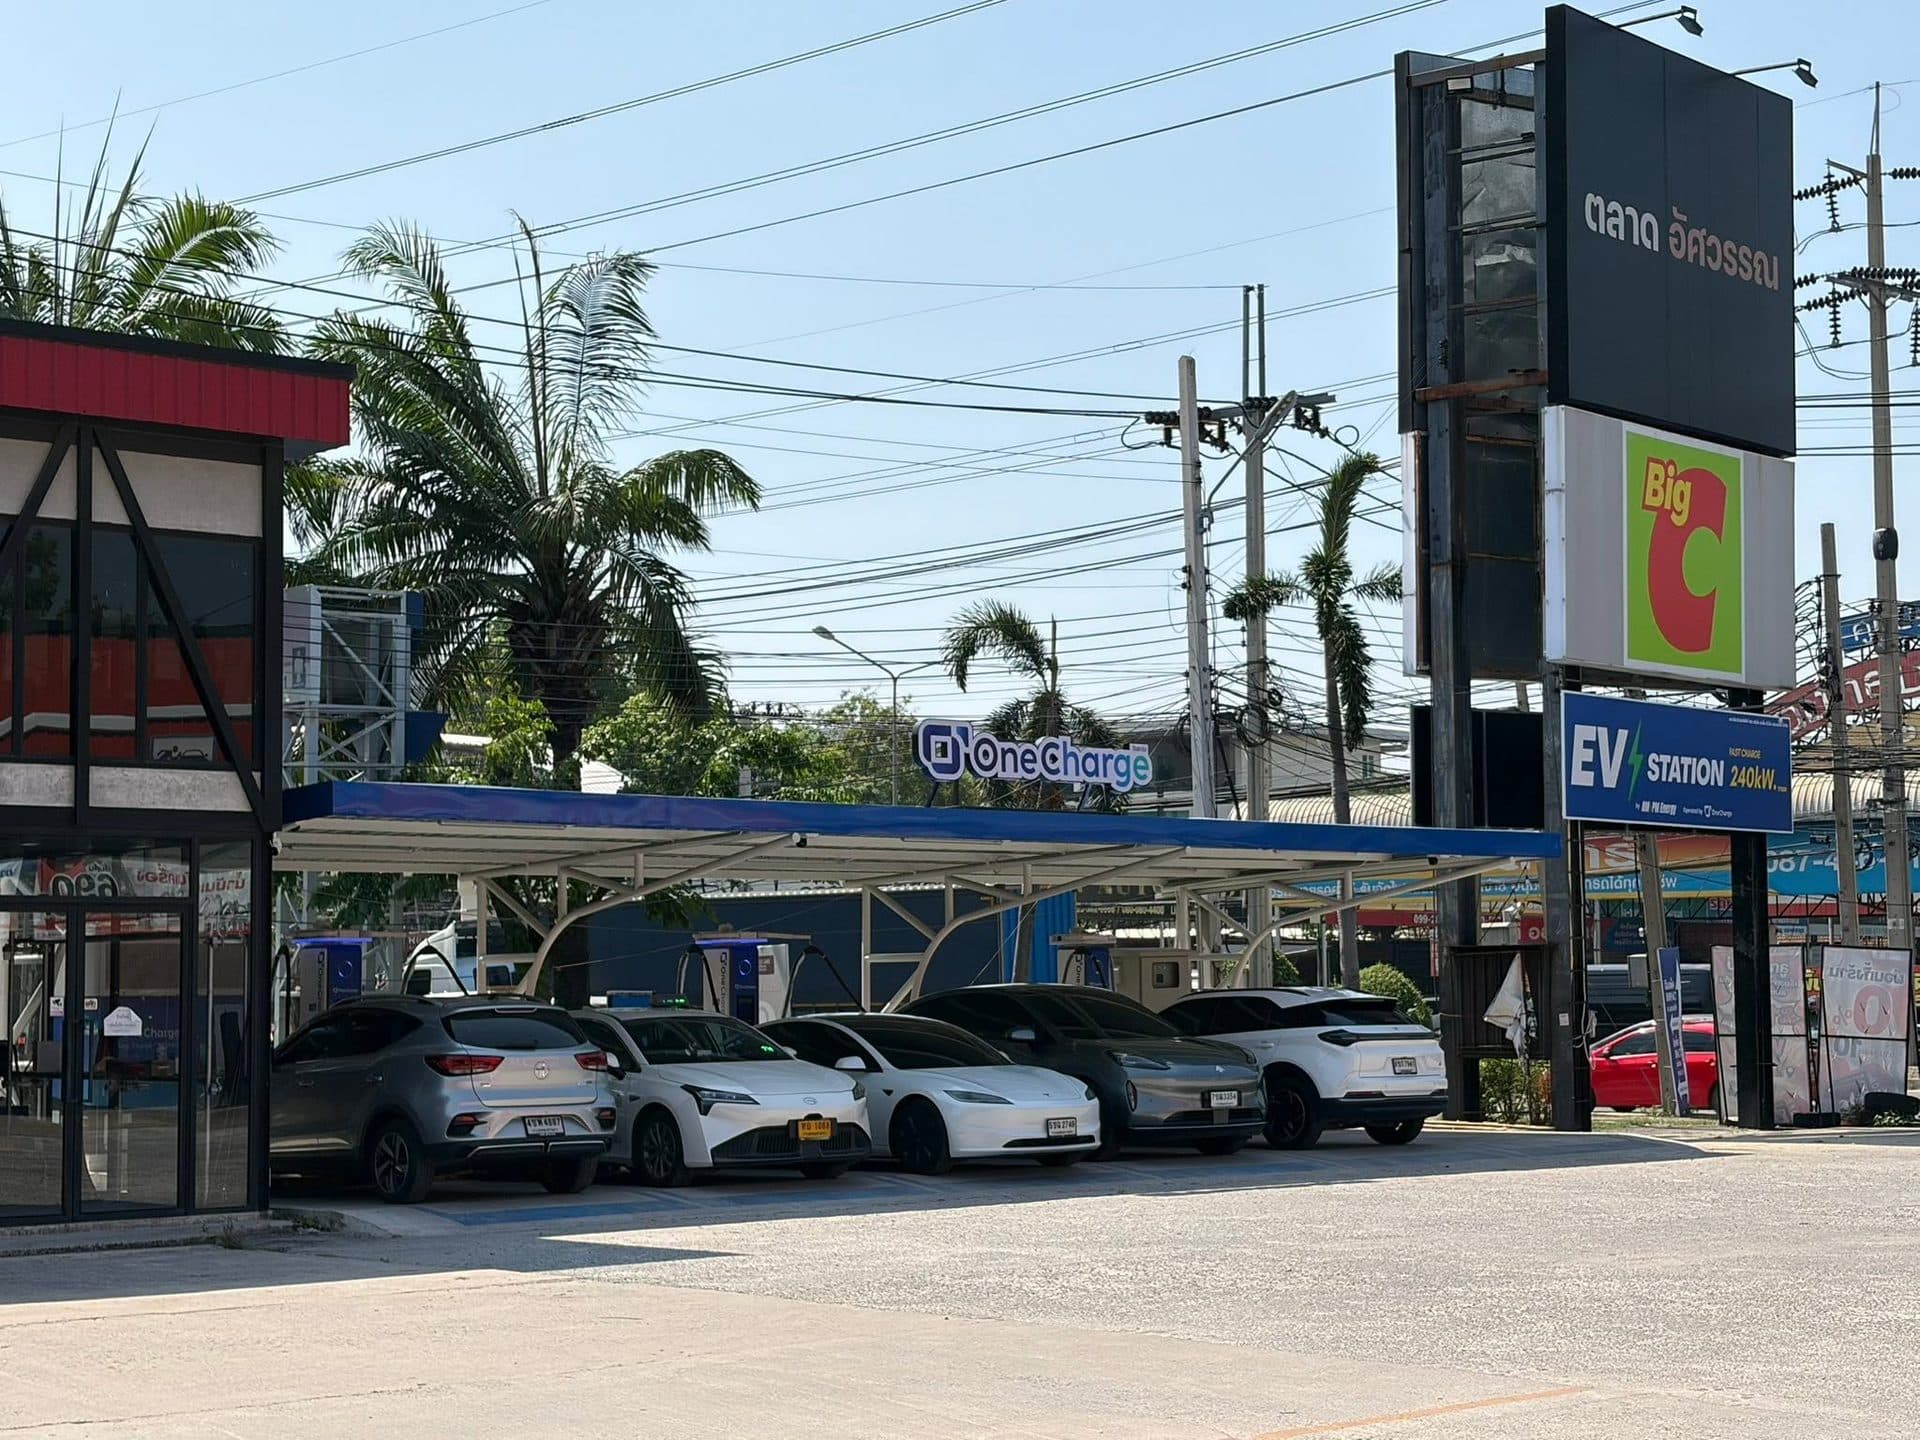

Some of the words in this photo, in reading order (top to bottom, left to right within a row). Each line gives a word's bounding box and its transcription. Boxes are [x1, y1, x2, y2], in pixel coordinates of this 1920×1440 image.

[1585, 193, 1659, 252] ตลาด
[1668, 206, 1779, 290] อัศวรรณ
[1643, 458, 1693, 527] Big
[1647, 467, 1727, 655] C
[973, 738, 1150, 787] OneCharge
[1570, 724, 1629, 789] EV
[1647, 752, 1725, 788] STATION
